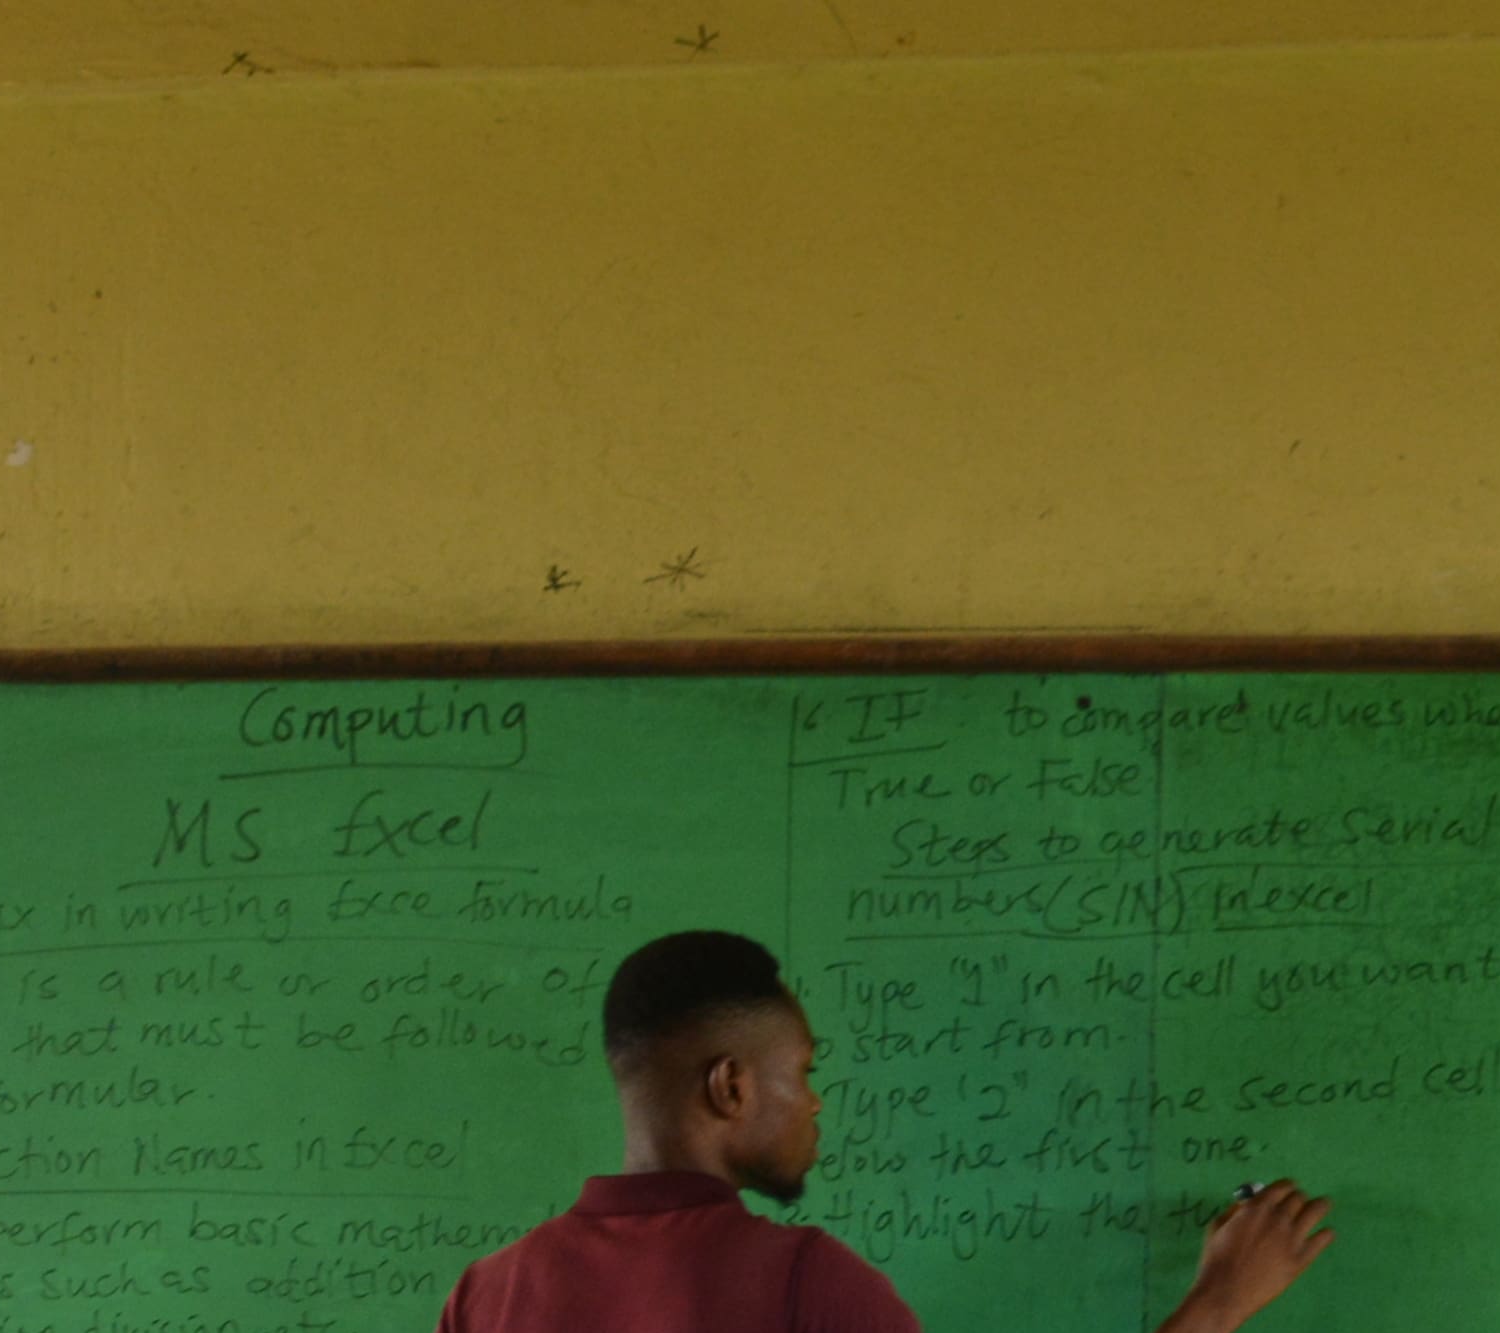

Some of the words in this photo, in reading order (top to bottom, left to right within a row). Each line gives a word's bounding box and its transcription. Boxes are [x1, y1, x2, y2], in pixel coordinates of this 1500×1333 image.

[240, 687, 529, 771] Computing
[1006, 691, 1048, 736] to
[829, 768, 951, 808] True
[969, 773, 1012, 797] or
[1028, 757, 1141, 799] False
[153, 797, 263, 868] MS
[333, 789, 491, 860] Excel
[1039, 825, 1080, 859] to
[1100, 810, 1315, 876] generate
[63, 891, 97, 932] in
[117, 886, 292, 942] writing
[19, 970, 56, 1003] is
[99, 978, 128, 1000] a
[155, 957, 254, 998] rule
[362, 960, 503, 1003] order
[542, 958, 606, 1008] of
[825, 961, 924, 1034] Type
[1022, 972, 1059, 1004] in
[1086, 955, 1149, 1000] the
[1162, 954, 1236, 998] cell
[1258, 968, 1344, 1012] you
[13, 1017, 120, 1058] that
[139, 1015, 268, 1051] must
[297, 1012, 362, 1053] be
[381, 1004, 592, 1068] followed
[851, 1017, 971, 1064] start
[822, 1079, 934, 1144] Type
[1116, 1079, 1209, 1118] the
[1235, 1056, 1401, 1111] second
[293, 1120, 328, 1168] in
[930, 1131, 1007, 1180] the
[1022, 1127, 1151, 1172] first
[188, 1203, 317, 1245] basic
[825, 1187, 1056, 1260] Highlight
[1082, 1189, 1147, 1238] the
[160, 1269, 210, 1296] as
[245, 1260, 436, 1299] addition
